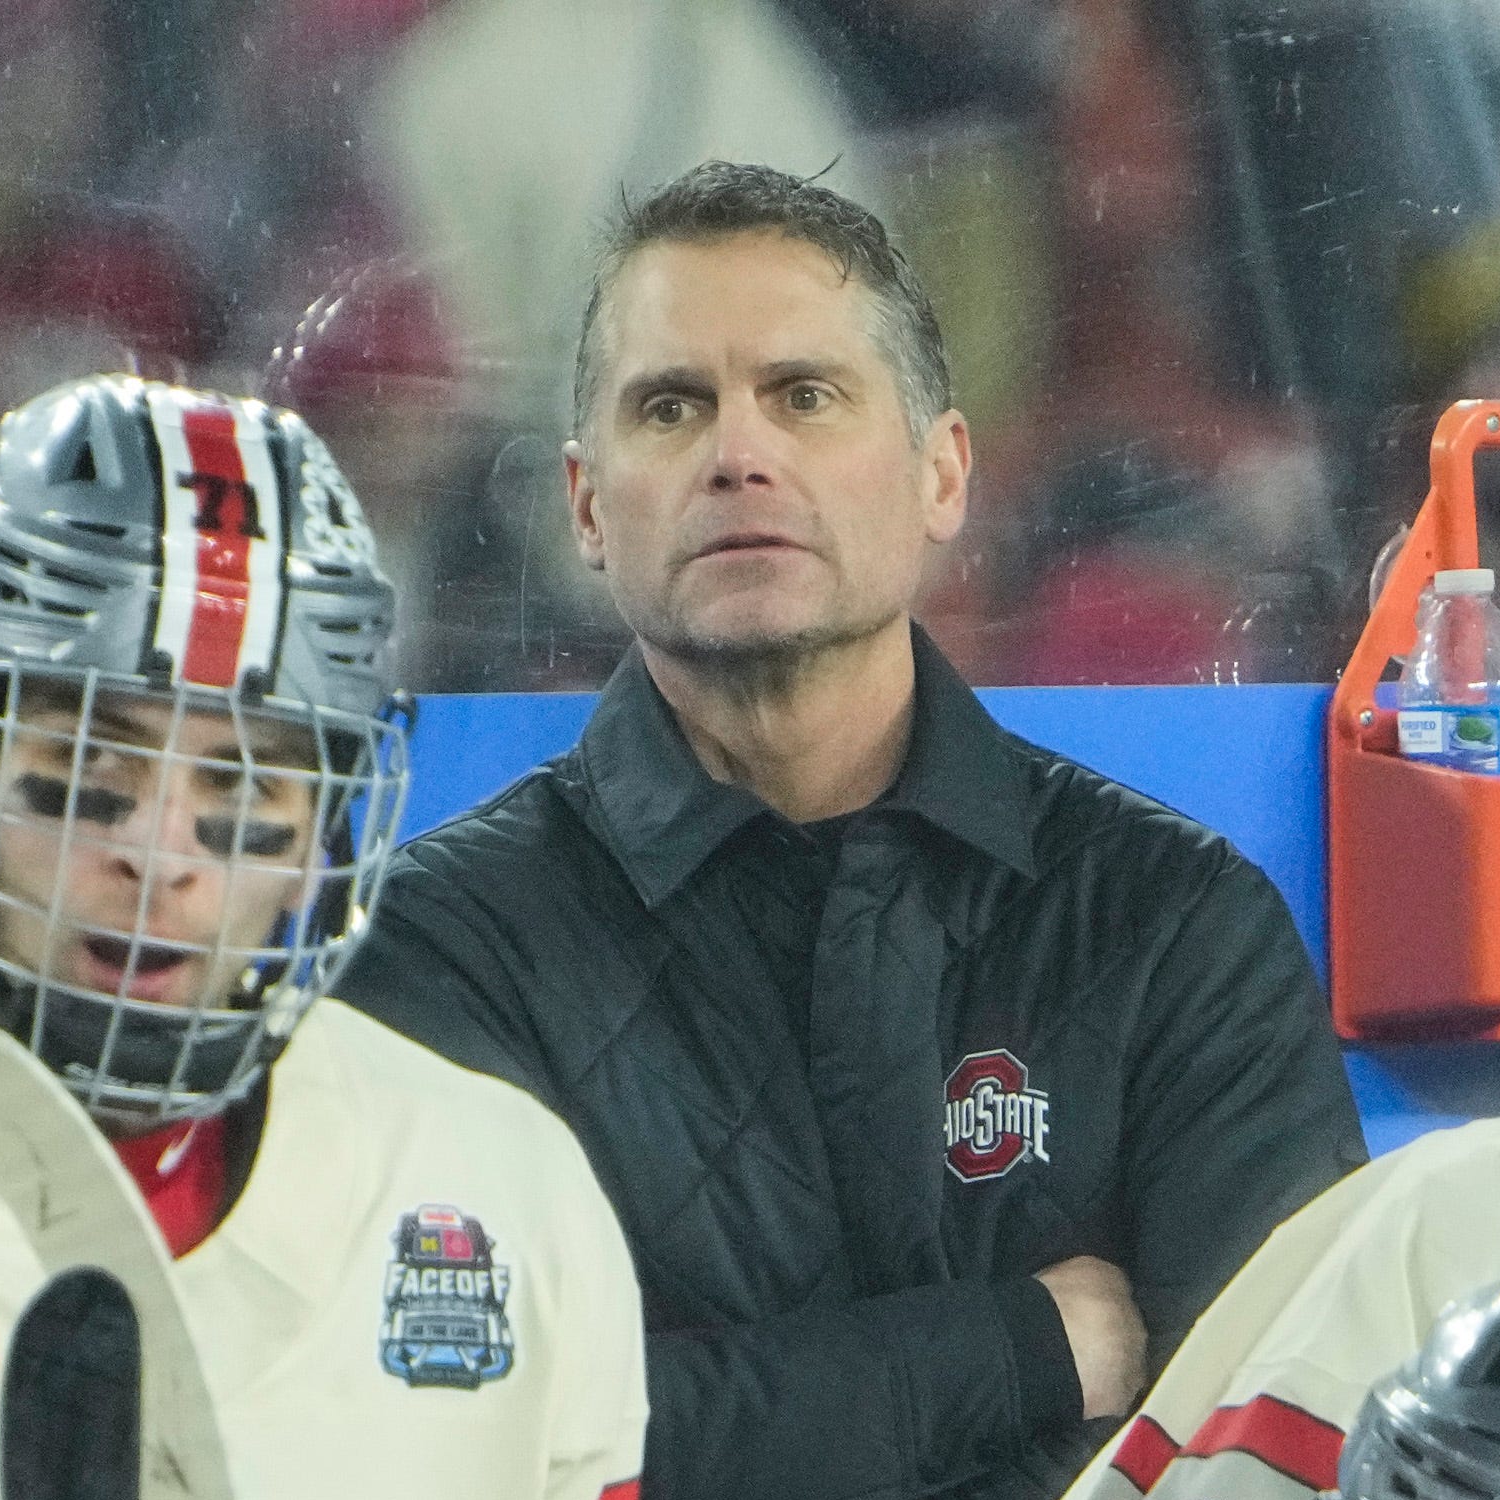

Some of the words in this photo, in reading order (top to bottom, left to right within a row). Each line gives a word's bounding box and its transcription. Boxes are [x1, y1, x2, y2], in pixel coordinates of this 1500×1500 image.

[176, 470, 267, 541] 71
[976, 1085, 1050, 1162] STATE
[386, 1262, 510, 1304] FACEOFF
